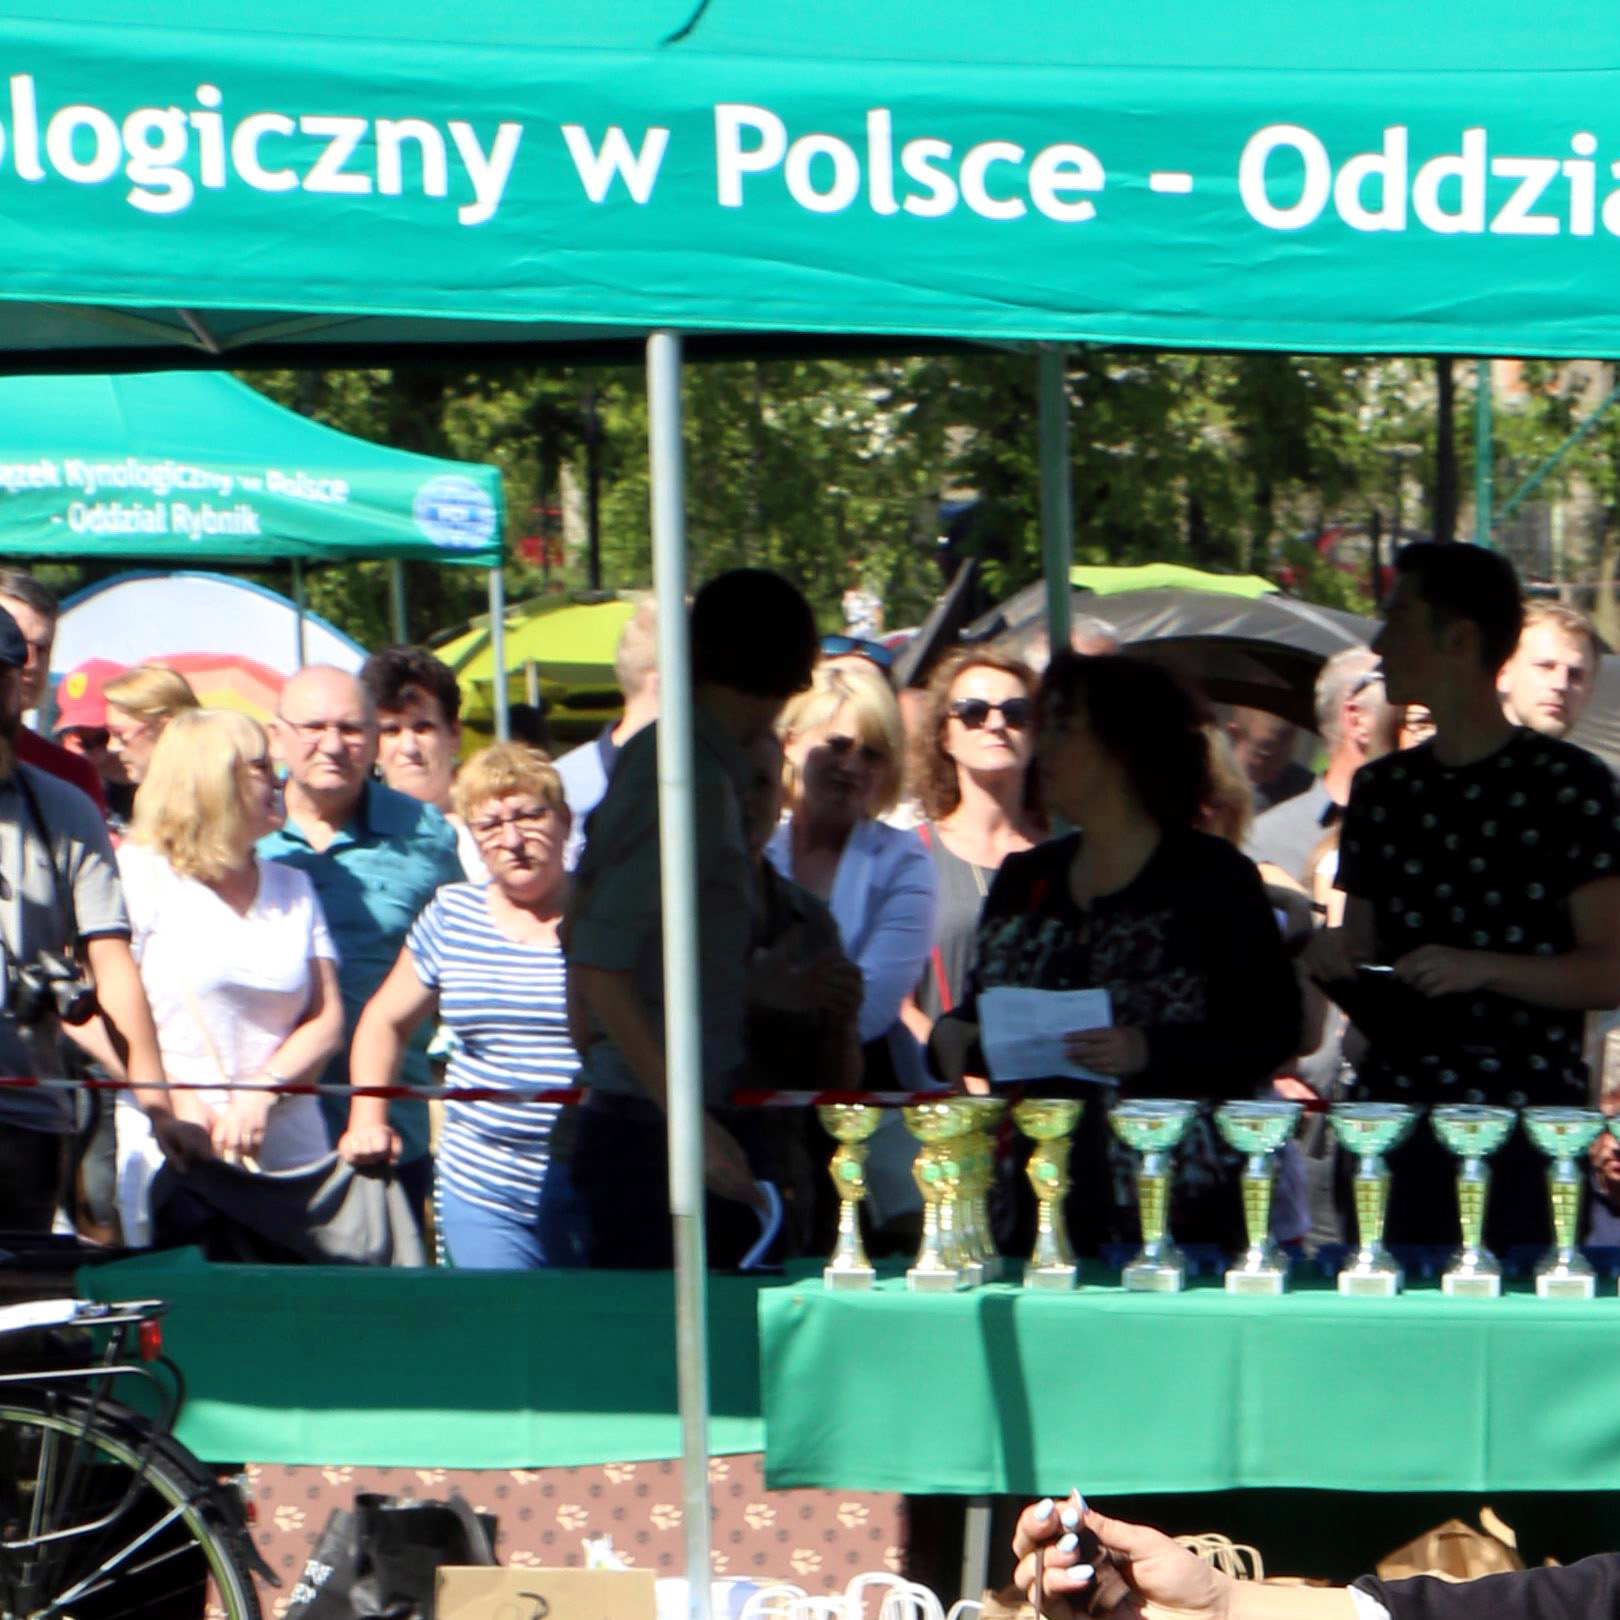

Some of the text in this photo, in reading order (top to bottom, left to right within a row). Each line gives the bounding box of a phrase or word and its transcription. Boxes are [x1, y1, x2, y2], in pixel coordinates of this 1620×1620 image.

[0, 74, 522, 226] logiczny
[562, 125, 669, 204] w
[714, 103, 1106, 223] Polsce
[63, 457, 234, 496] Kynologiczny
[265, 468, 349, 503] Polsce
[171, 501, 260, 541] Rybnik
